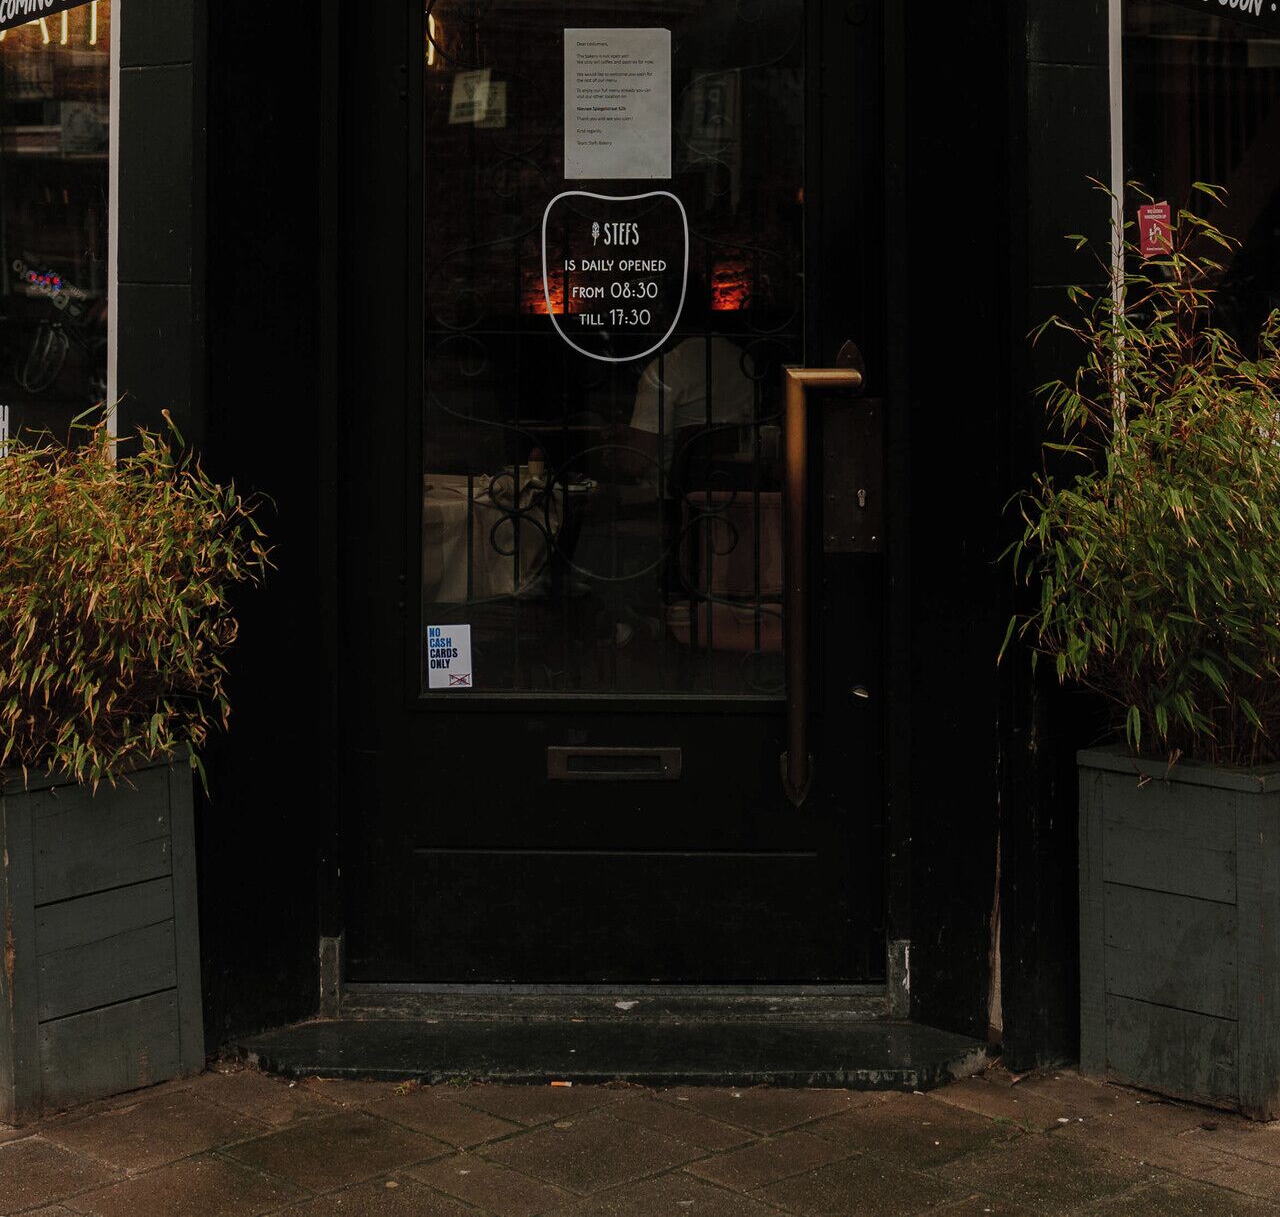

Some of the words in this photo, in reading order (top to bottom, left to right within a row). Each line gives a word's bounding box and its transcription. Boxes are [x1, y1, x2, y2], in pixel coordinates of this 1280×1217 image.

[603, 222, 640, 246] STEFS
[564, 259, 576, 272] IS
[581, 259, 614, 272] DAILY
[618, 259, 667, 272] OPENED
[572, 286, 605, 299] FROM
[610, 281, 658, 299] 08:30
[578, 313, 605, 326] TILL
[609, 308, 651, 326] 17:30
[429, 628, 441, 638] NO
[429, 638, 452, 648] CASH
[430, 648, 458, 659] CARDS
[430, 659, 451, 669] ONLY
